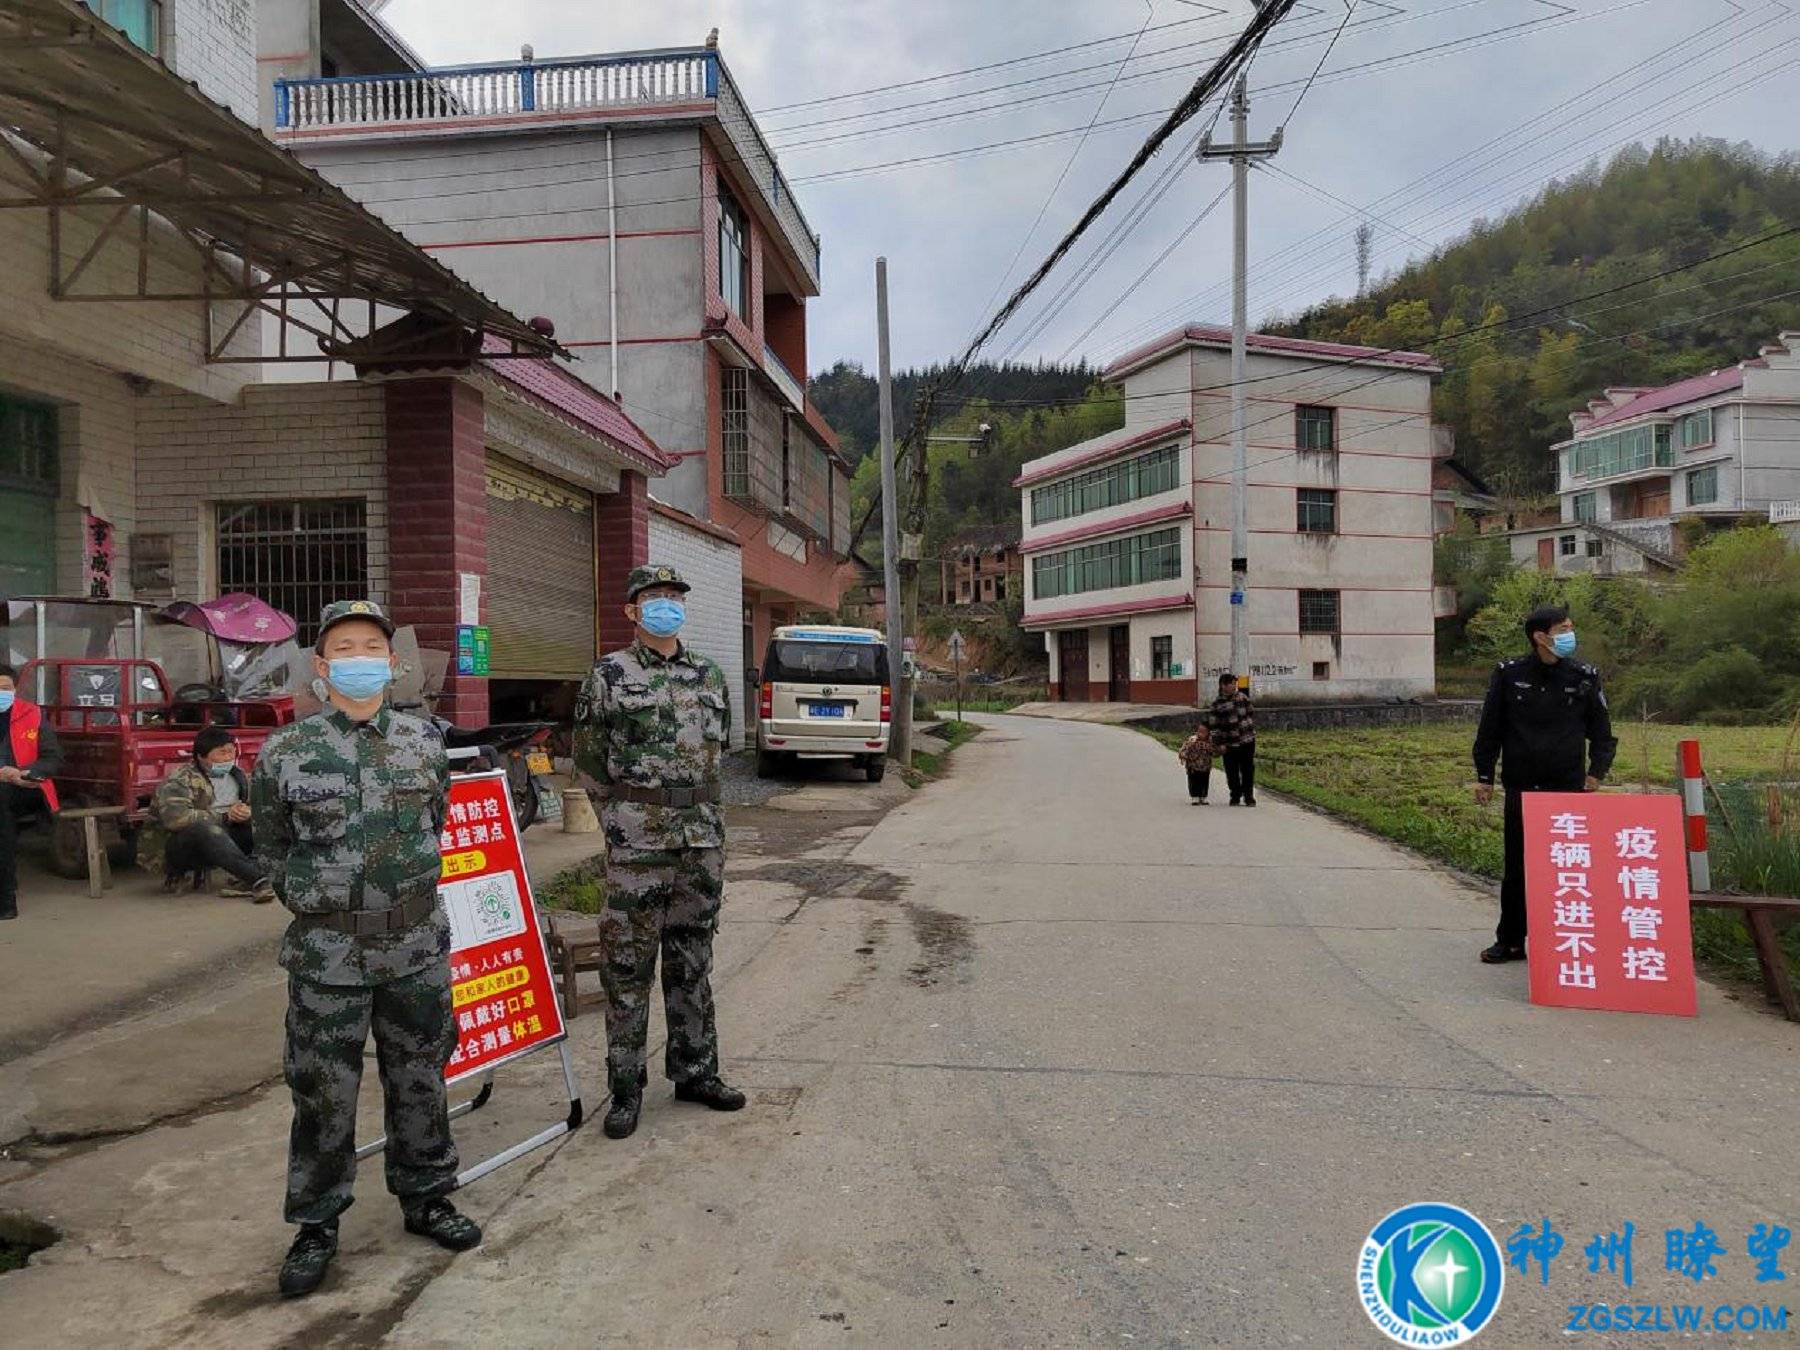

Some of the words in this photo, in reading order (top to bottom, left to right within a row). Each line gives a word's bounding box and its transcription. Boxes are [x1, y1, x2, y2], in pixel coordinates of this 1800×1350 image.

[446, 798, 501, 825] 情防控
[446, 854, 478, 872] 出示
[1550, 812, 1596, 990] 车辆只进不出
[1614, 826, 1669, 982] 疫情管控
